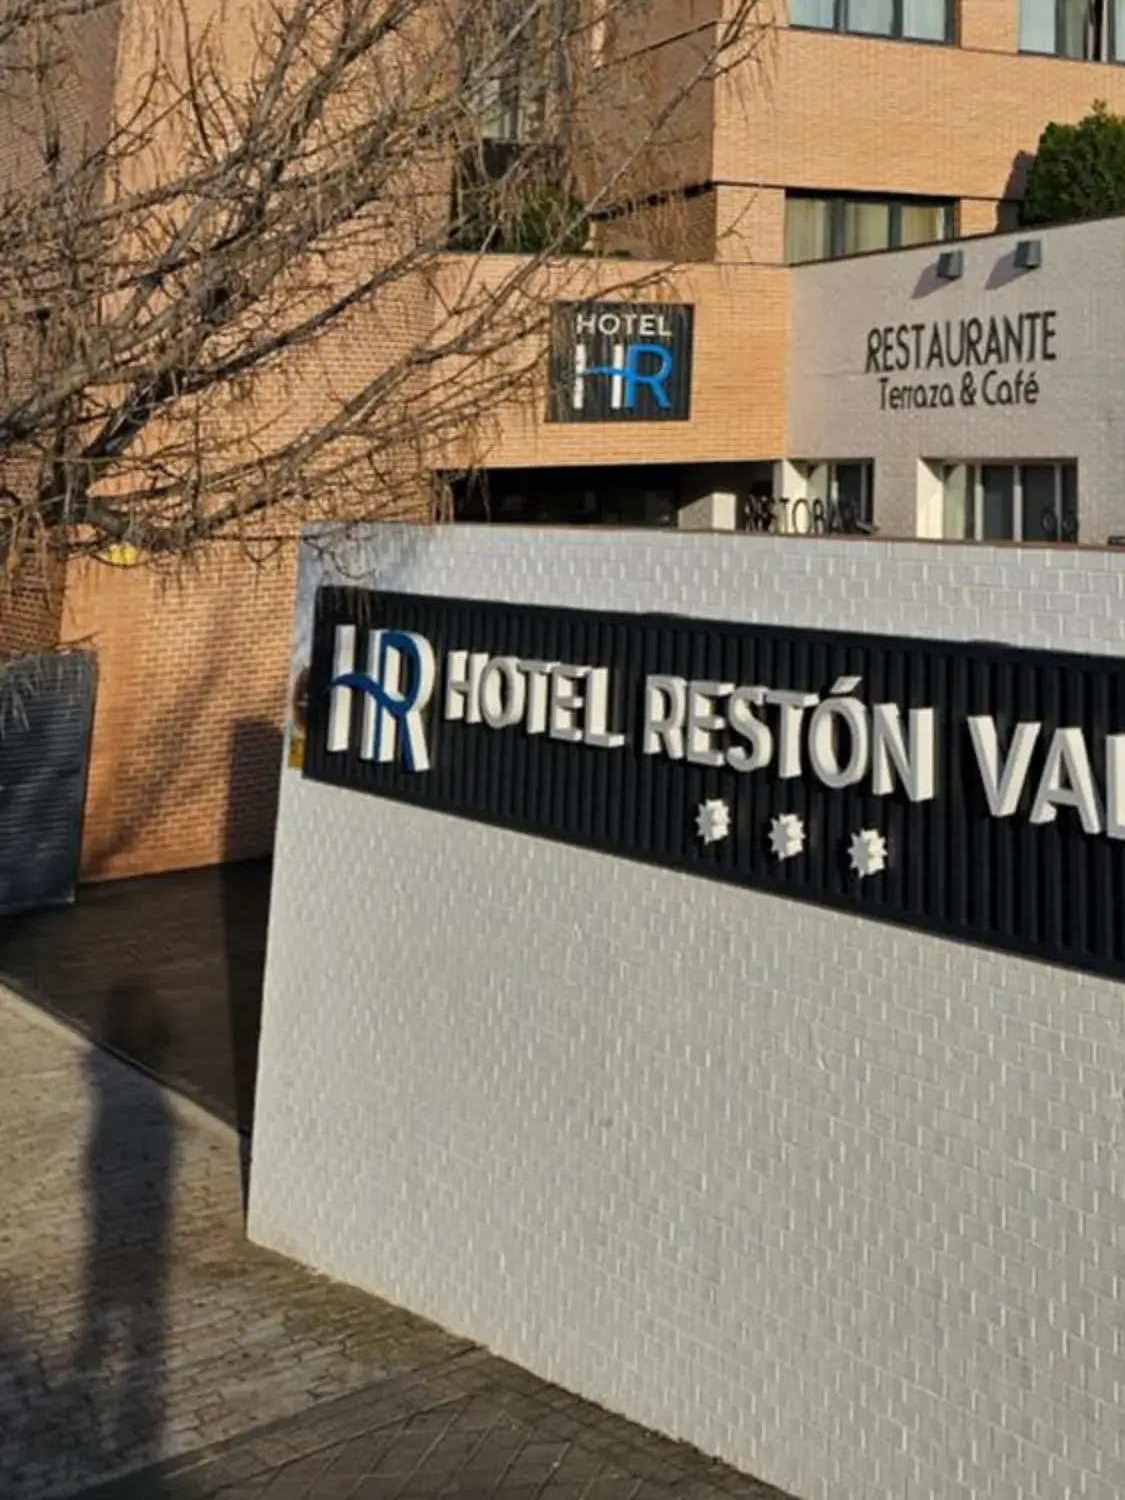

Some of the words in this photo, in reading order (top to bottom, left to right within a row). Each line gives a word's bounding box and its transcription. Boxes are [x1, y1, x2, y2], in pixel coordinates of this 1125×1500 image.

[576, 313, 672, 337] HOTEL
[865, 310, 1057, 374] RESTAURANTE
[878, 376, 956, 410] Terraza
[959, 370, 978, 407] &
[982, 367, 1040, 406] Café
[445, 650, 625, 748] HOTEL
[643, 675, 935, 803] RESTÓN
